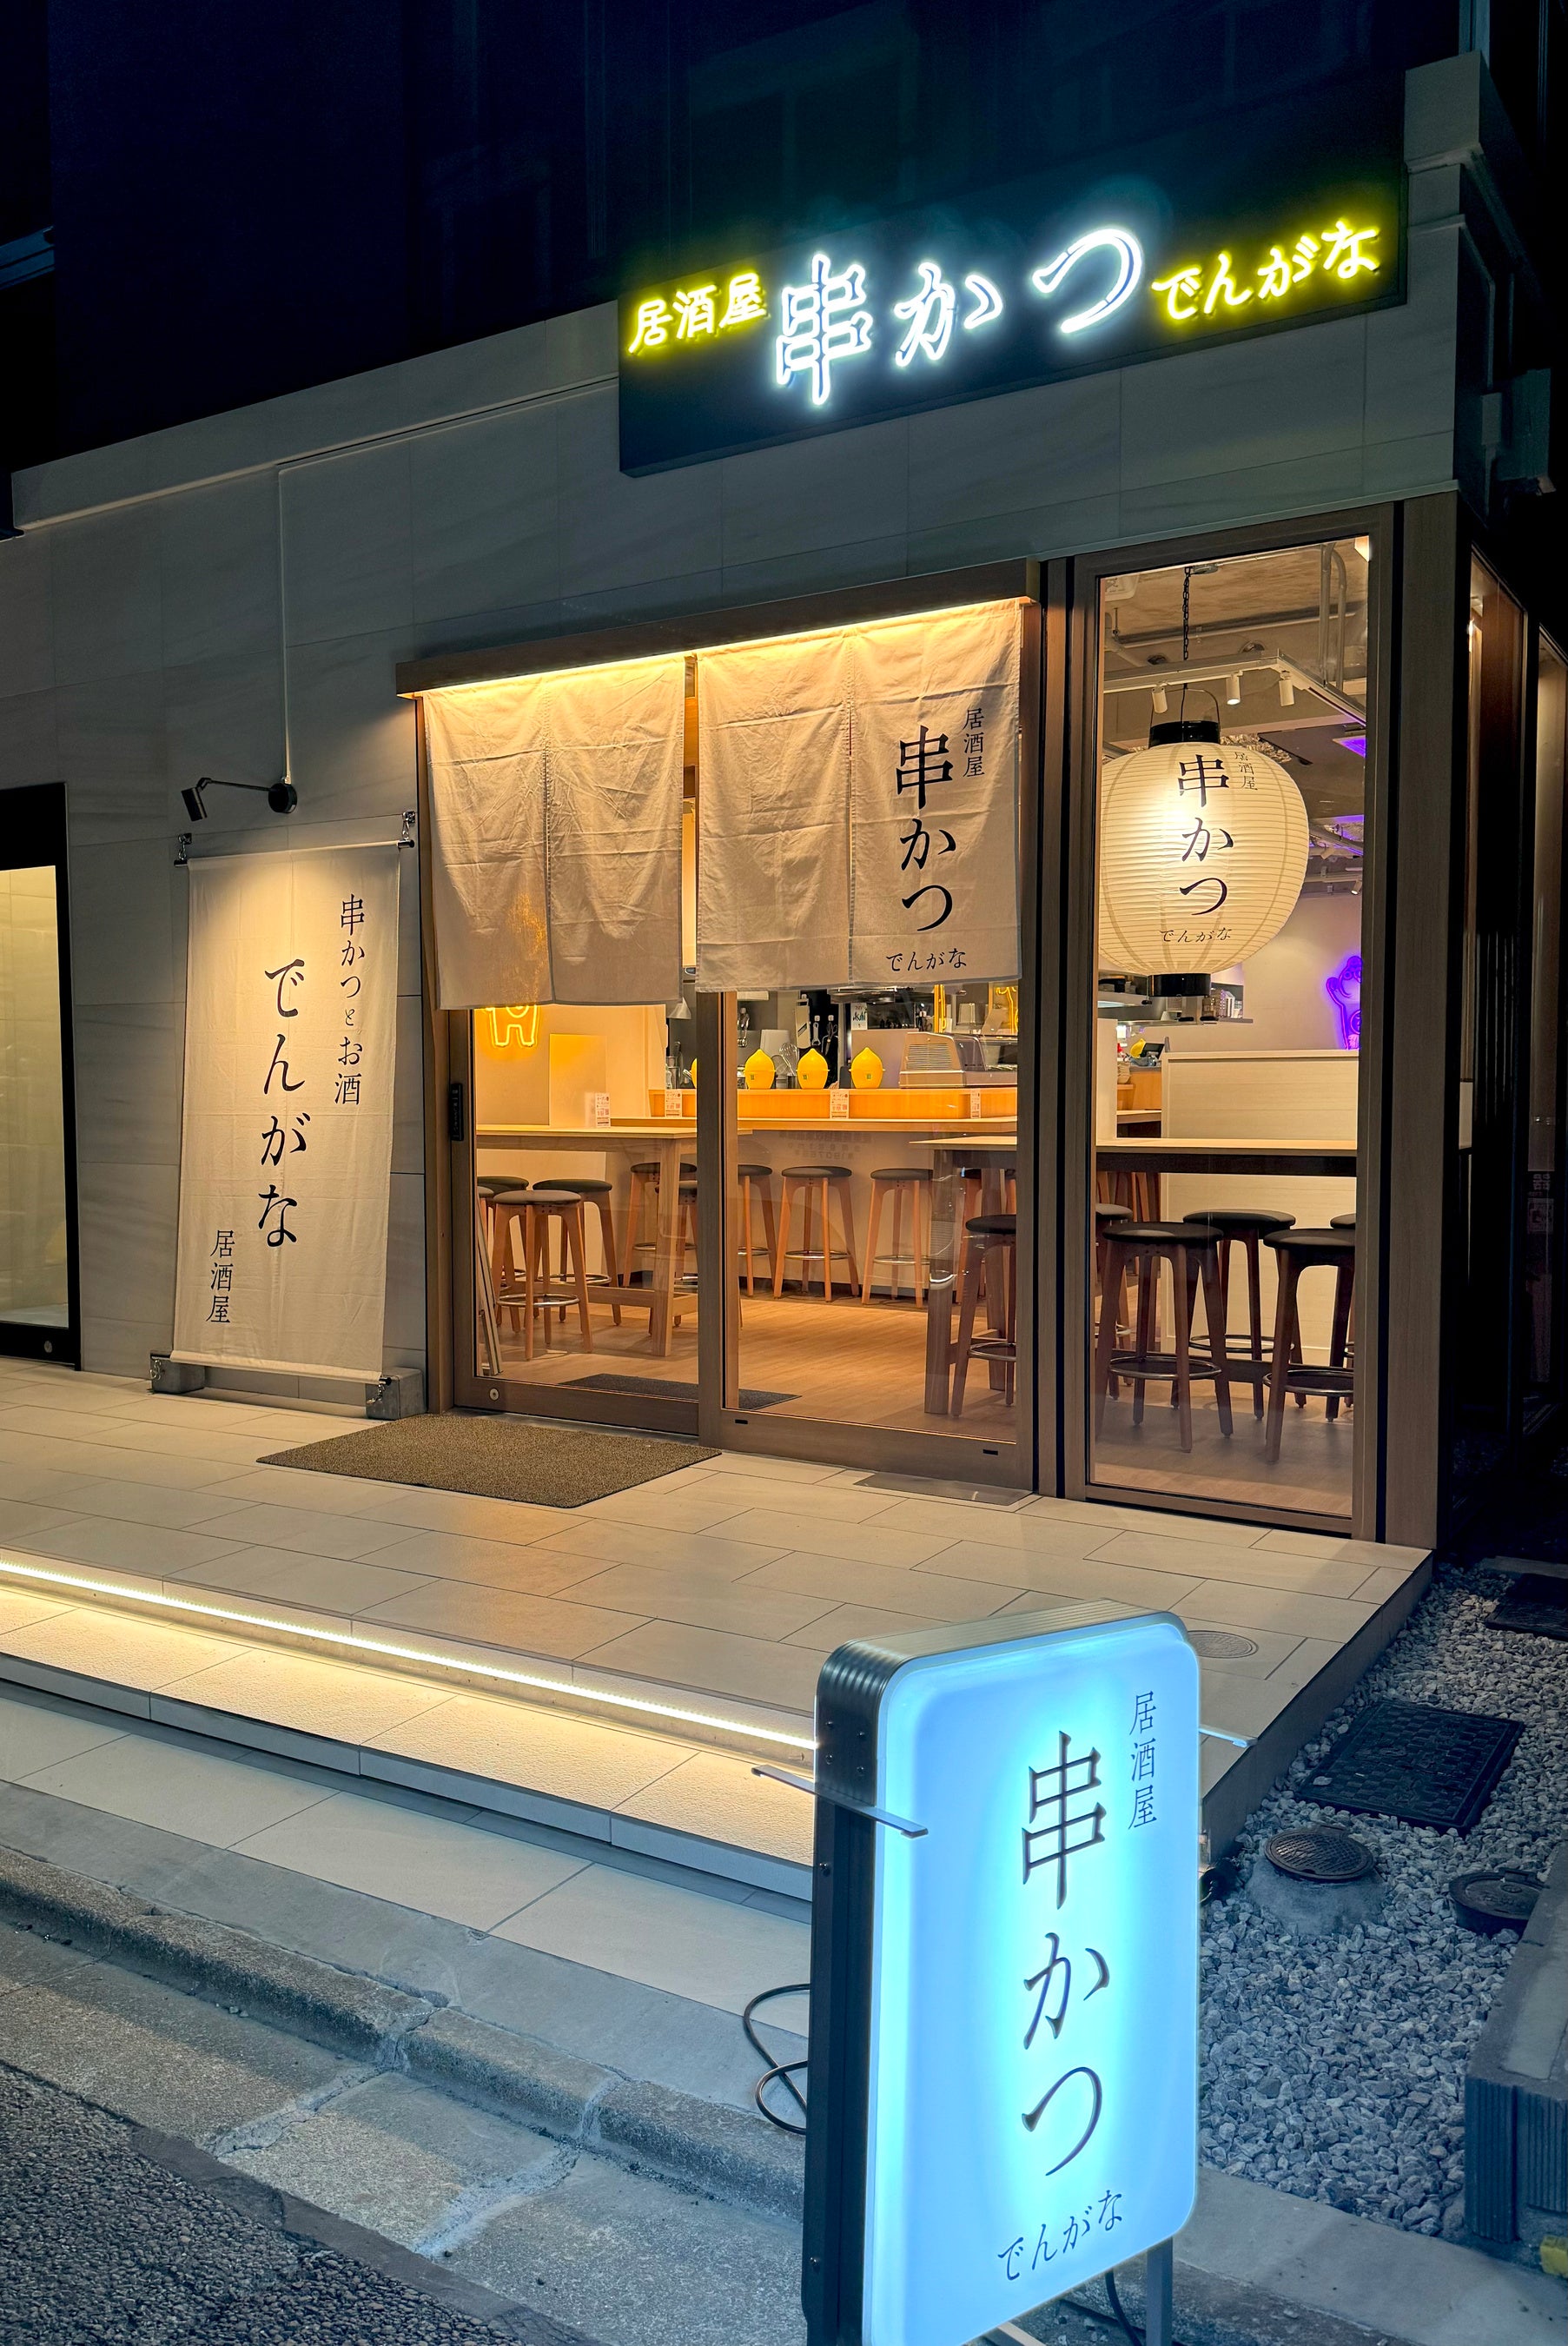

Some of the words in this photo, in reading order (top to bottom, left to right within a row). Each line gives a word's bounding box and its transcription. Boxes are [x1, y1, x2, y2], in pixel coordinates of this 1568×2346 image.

[628, 272, 767, 355] 居酒屋
[776, 228, 1142, 405] 串かつ
[1150, 219, 1379, 320] でんがな
[962, 707, 985, 778] 居酒屋
[895, 725, 956, 932] 串かつ
[1178, 754, 1234, 916] 串かつ
[334, 893, 366, 1105] 串かつとお酒
[885, 947, 967, 972] でんがな
[1159, 927, 1233, 943] でんがな
[257, 958, 311, 1248] でんがな
[205, 1229, 235, 1323] 居酒屋
[1128, 1690, 1158, 1831] 居酒屋
[1021, 1730, 1110, 2177] 串かつ
[997, 2189, 1123, 2282] でんがな
